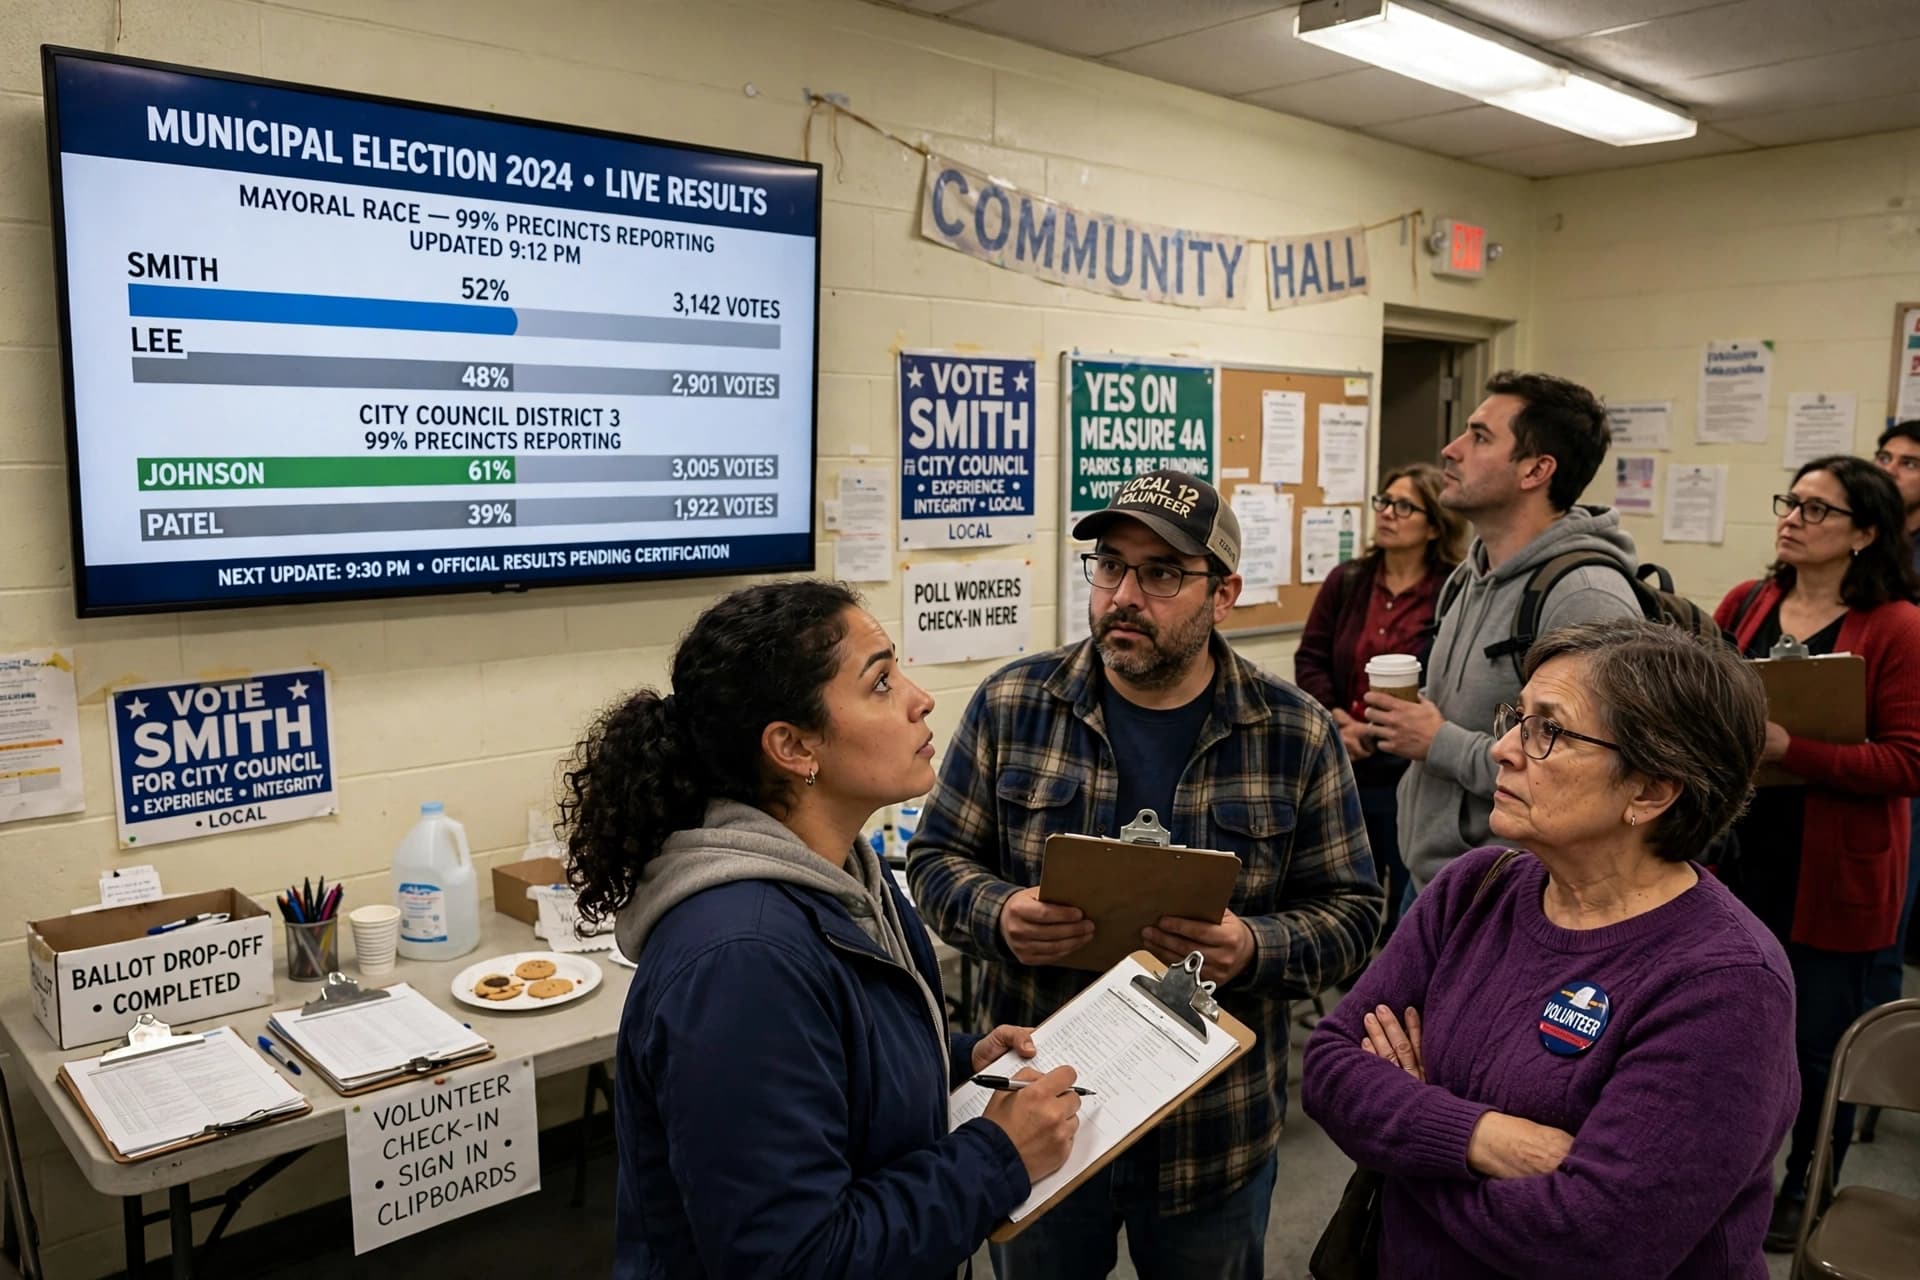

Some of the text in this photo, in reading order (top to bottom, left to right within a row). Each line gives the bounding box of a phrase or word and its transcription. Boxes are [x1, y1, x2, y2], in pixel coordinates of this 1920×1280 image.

[147, 105, 768, 216] MUNICIPAL ELECTION 2024 LIVE RESULTS
[239, 184, 715, 253] MAYORAL RACE 99% PRECINCTS REPORTING
[410, 230, 581, 264] UPDATED 9:12 PM
[931, 168, 1367, 300] COMMUNITY HALL
[127, 251, 218, 282] SMITH
[461, 277, 509, 301] 52%
[673, 292, 780, 319] 3,142 VOTES
[131, 326, 184, 353] LEE
[461, 365, 509, 389] 48%
[672, 373, 776, 397] 2,901 VOTES
[930, 362, 1005, 396] VOTE
[1084, 371, 1177, 414] YES ON
[359, 404, 621, 428] CITY COUNCIL DISTRICT 3
[908, 397, 1029, 450] SMITH
[364, 431, 622, 450] 99% PRECINCTS REPORTING
[1080, 416, 1207, 451] MEASURE 4A
[143, 461, 265, 487] JOHNSON
[468, 459, 511, 482] 61%
[672, 457, 774, 481] 3,005 VOTES
[917, 455, 956, 476] CITY
[959, 455, 1029, 476] COUNCIL
[1079, 456, 1121, 476] PARKS
[1122, 456, 1133, 475] &
[1135, 456, 1158, 474] REC
[931, 479, 1006, 496] EXPERIENCE
[1121, 476, 1200, 508] LOCAL 12
[468, 503, 512, 526] 39%
[673, 496, 774, 521] 1,922 VOTES
[914, 496, 1025, 514] INTEGRITY LOCAL
[1117, 490, 1191, 519] VOLUNTEER
[147, 512, 224, 537] PATEL
[948, 522, 993, 541] LOCAL
[217, 543, 730, 587] NEXT UPDATE: 9:30 PM OFFICIAL RESULTS PENDING CERTIFICATION
[914, 577, 1022, 605] POLL WORKERS
[918, 605, 1018, 632] CHECK-IN HERE
[168, 681, 266, 717] VOTE
[133, 704, 313, 769] SMITH
[131, 751, 323, 796] FOR CITY COUNCIL
[143, 774, 324, 815] EXPERIENCE INTEGRITY
[208, 806, 267, 829] LOCAL
[71, 955, 156, 991] BALLOT
[163, 934, 264, 973] DROP-OFF
[112, 971, 241, 1015] COMPLETED
[1543, 1001, 1601, 1037] VOLUNTEER
[373, 1074, 512, 1131] VOLUNTEER
[382, 1107, 500, 1160] CHECK-IN
[399, 1139, 488, 1187] SIGN IN
[377, 1161, 517, 1226] CLIPBOARDS
